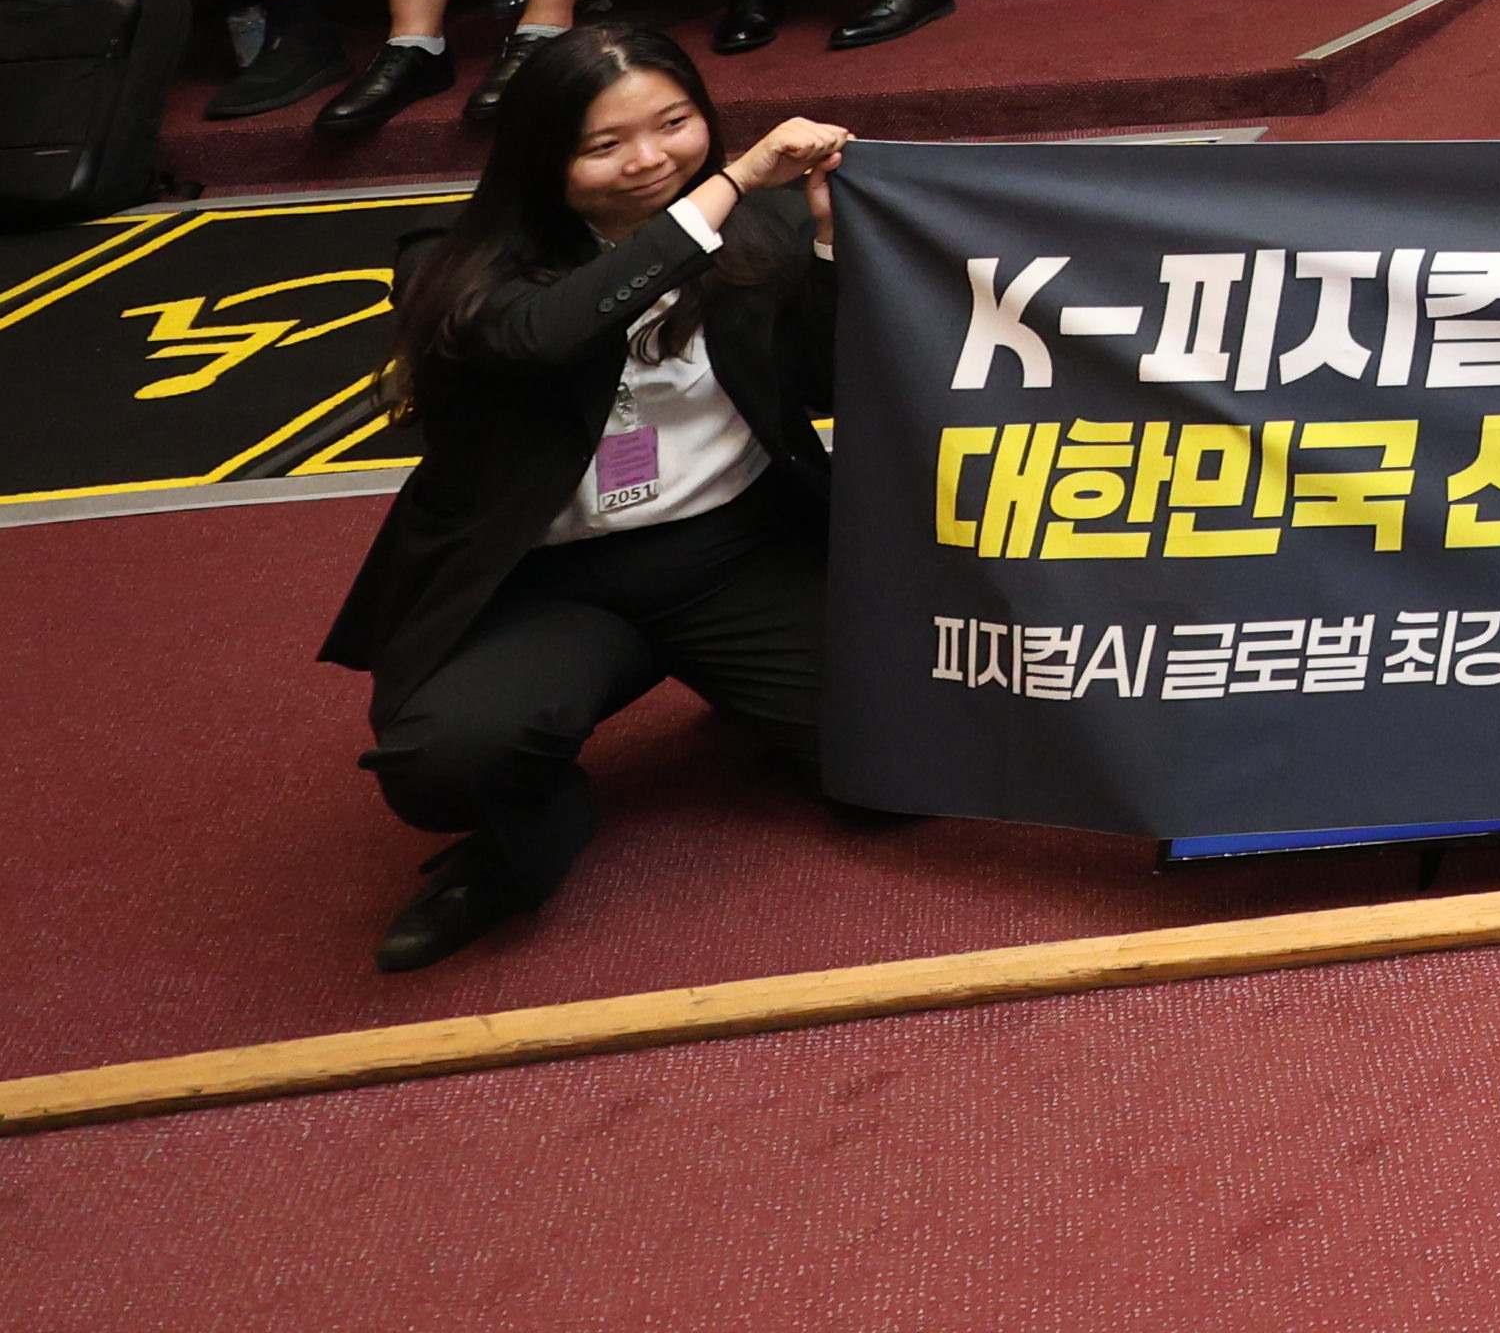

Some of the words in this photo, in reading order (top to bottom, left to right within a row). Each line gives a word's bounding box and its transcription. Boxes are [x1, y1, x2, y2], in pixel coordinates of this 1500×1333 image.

[605, 484, 651, 509] 2051
[937, 419, 1418, 559] 대한민국
[933, 617, 1156, 700] 피지컬AI
[1162, 615, 1375, 699] 글로벌
